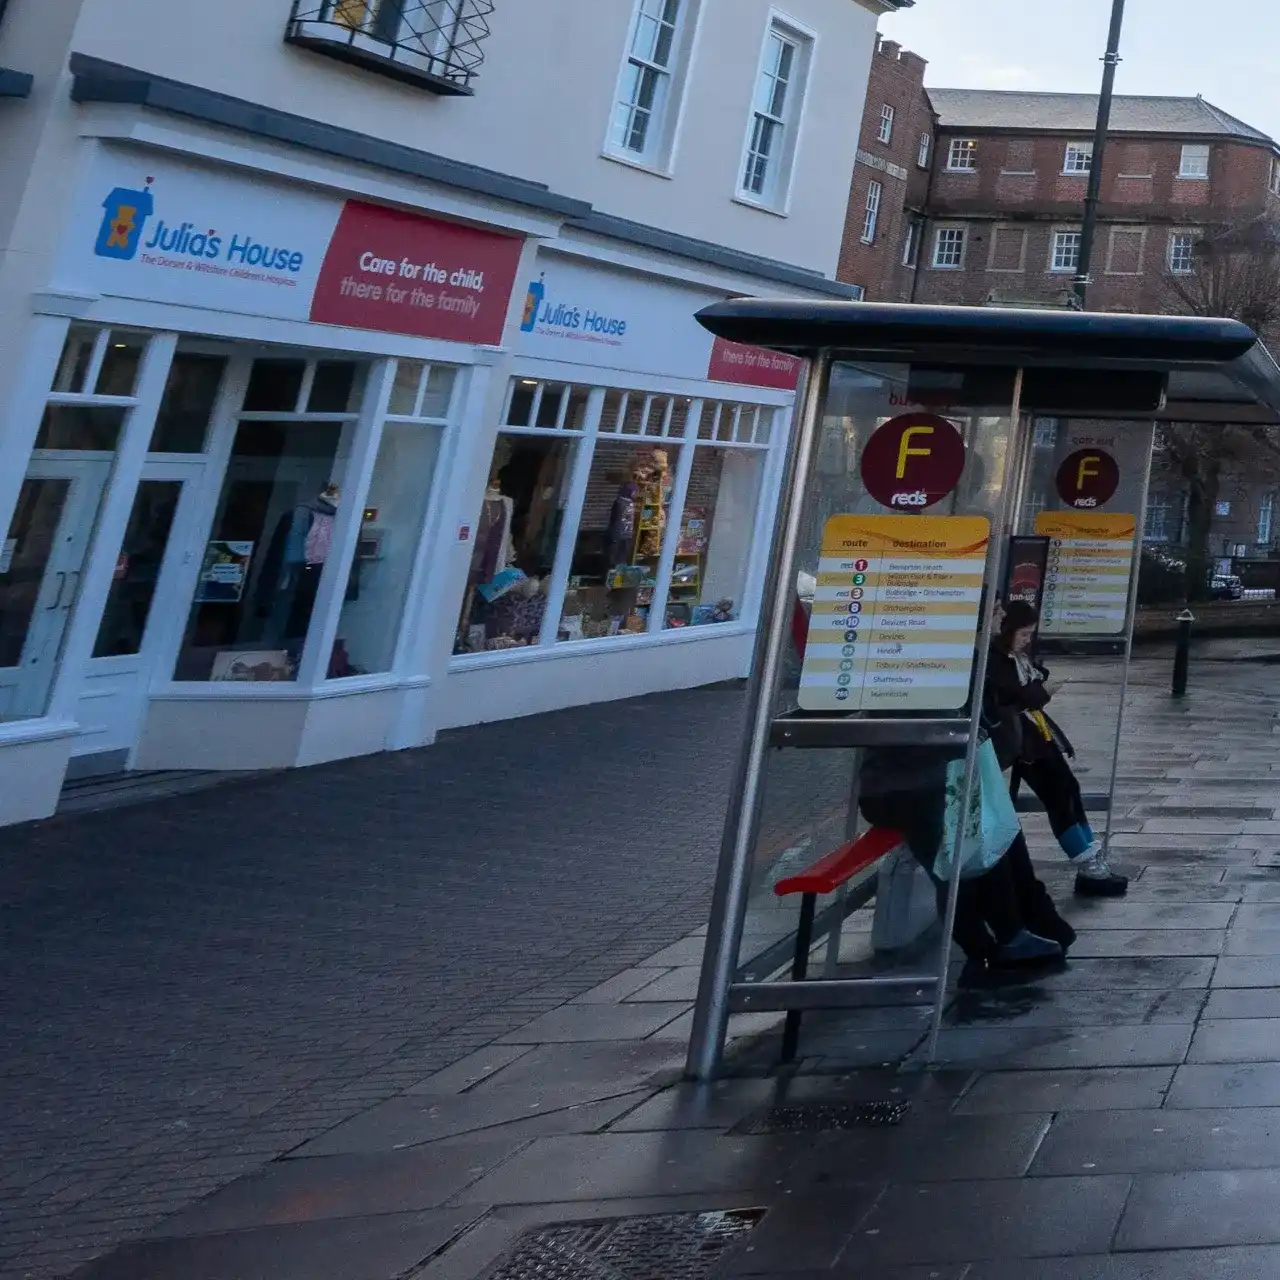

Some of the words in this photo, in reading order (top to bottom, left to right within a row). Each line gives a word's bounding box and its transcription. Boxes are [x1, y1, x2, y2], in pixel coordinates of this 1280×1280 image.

[145, 220, 222, 259] Julia's
[227, 234, 304, 272] House
[141, 253, 155, 265] The
[156, 256, 185, 270] Dorset
[359, 251, 396, 275] Care
[399, 257, 420, 279] for
[422, 262, 447, 285] the
[449, 267, 485, 293] child,
[340, 275, 381, 301] there
[386, 283, 409, 304] for
[410, 287, 434, 307] the
[436, 290, 481, 319] family
[538, 303, 581, 329] Julia's
[582, 309, 627, 337] House
[722, 349, 744, 366] there
[744, 351, 756, 367] for
[756, 353, 771, 368] the
[771, 355, 795, 375] family
[896, 426, 934, 479] F
[1077, 456, 1100, 490] F
[1074, 496, 1097, 508] reds
[842, 539, 868, 548] route
[892, 539, 947, 549] destination
[840, 561, 854, 569] red
[832, 618, 845, 626] red
